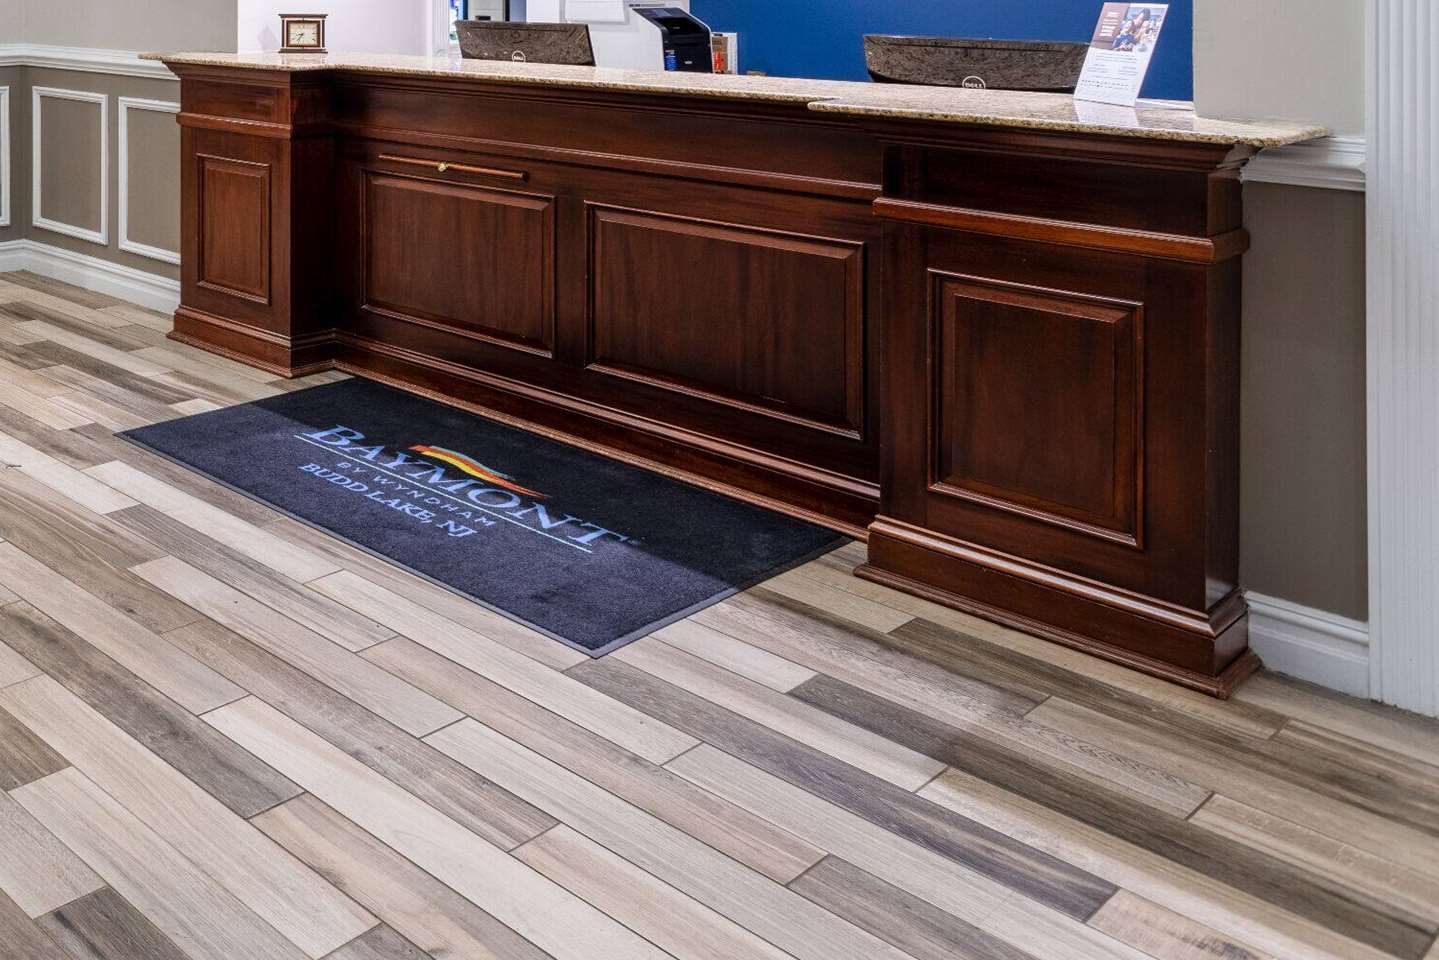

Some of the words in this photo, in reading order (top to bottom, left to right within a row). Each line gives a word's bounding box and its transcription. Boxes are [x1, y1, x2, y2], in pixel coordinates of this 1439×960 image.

[297, 463, 369, 492] BUDD
[364, 490, 436, 524] LAKE,
[436, 519, 479, 538] NJ
[302, 424, 629, 547] BAYMONT
[336, 462, 366, 474] BY
[372, 475, 497, 527] WYNDHAM
